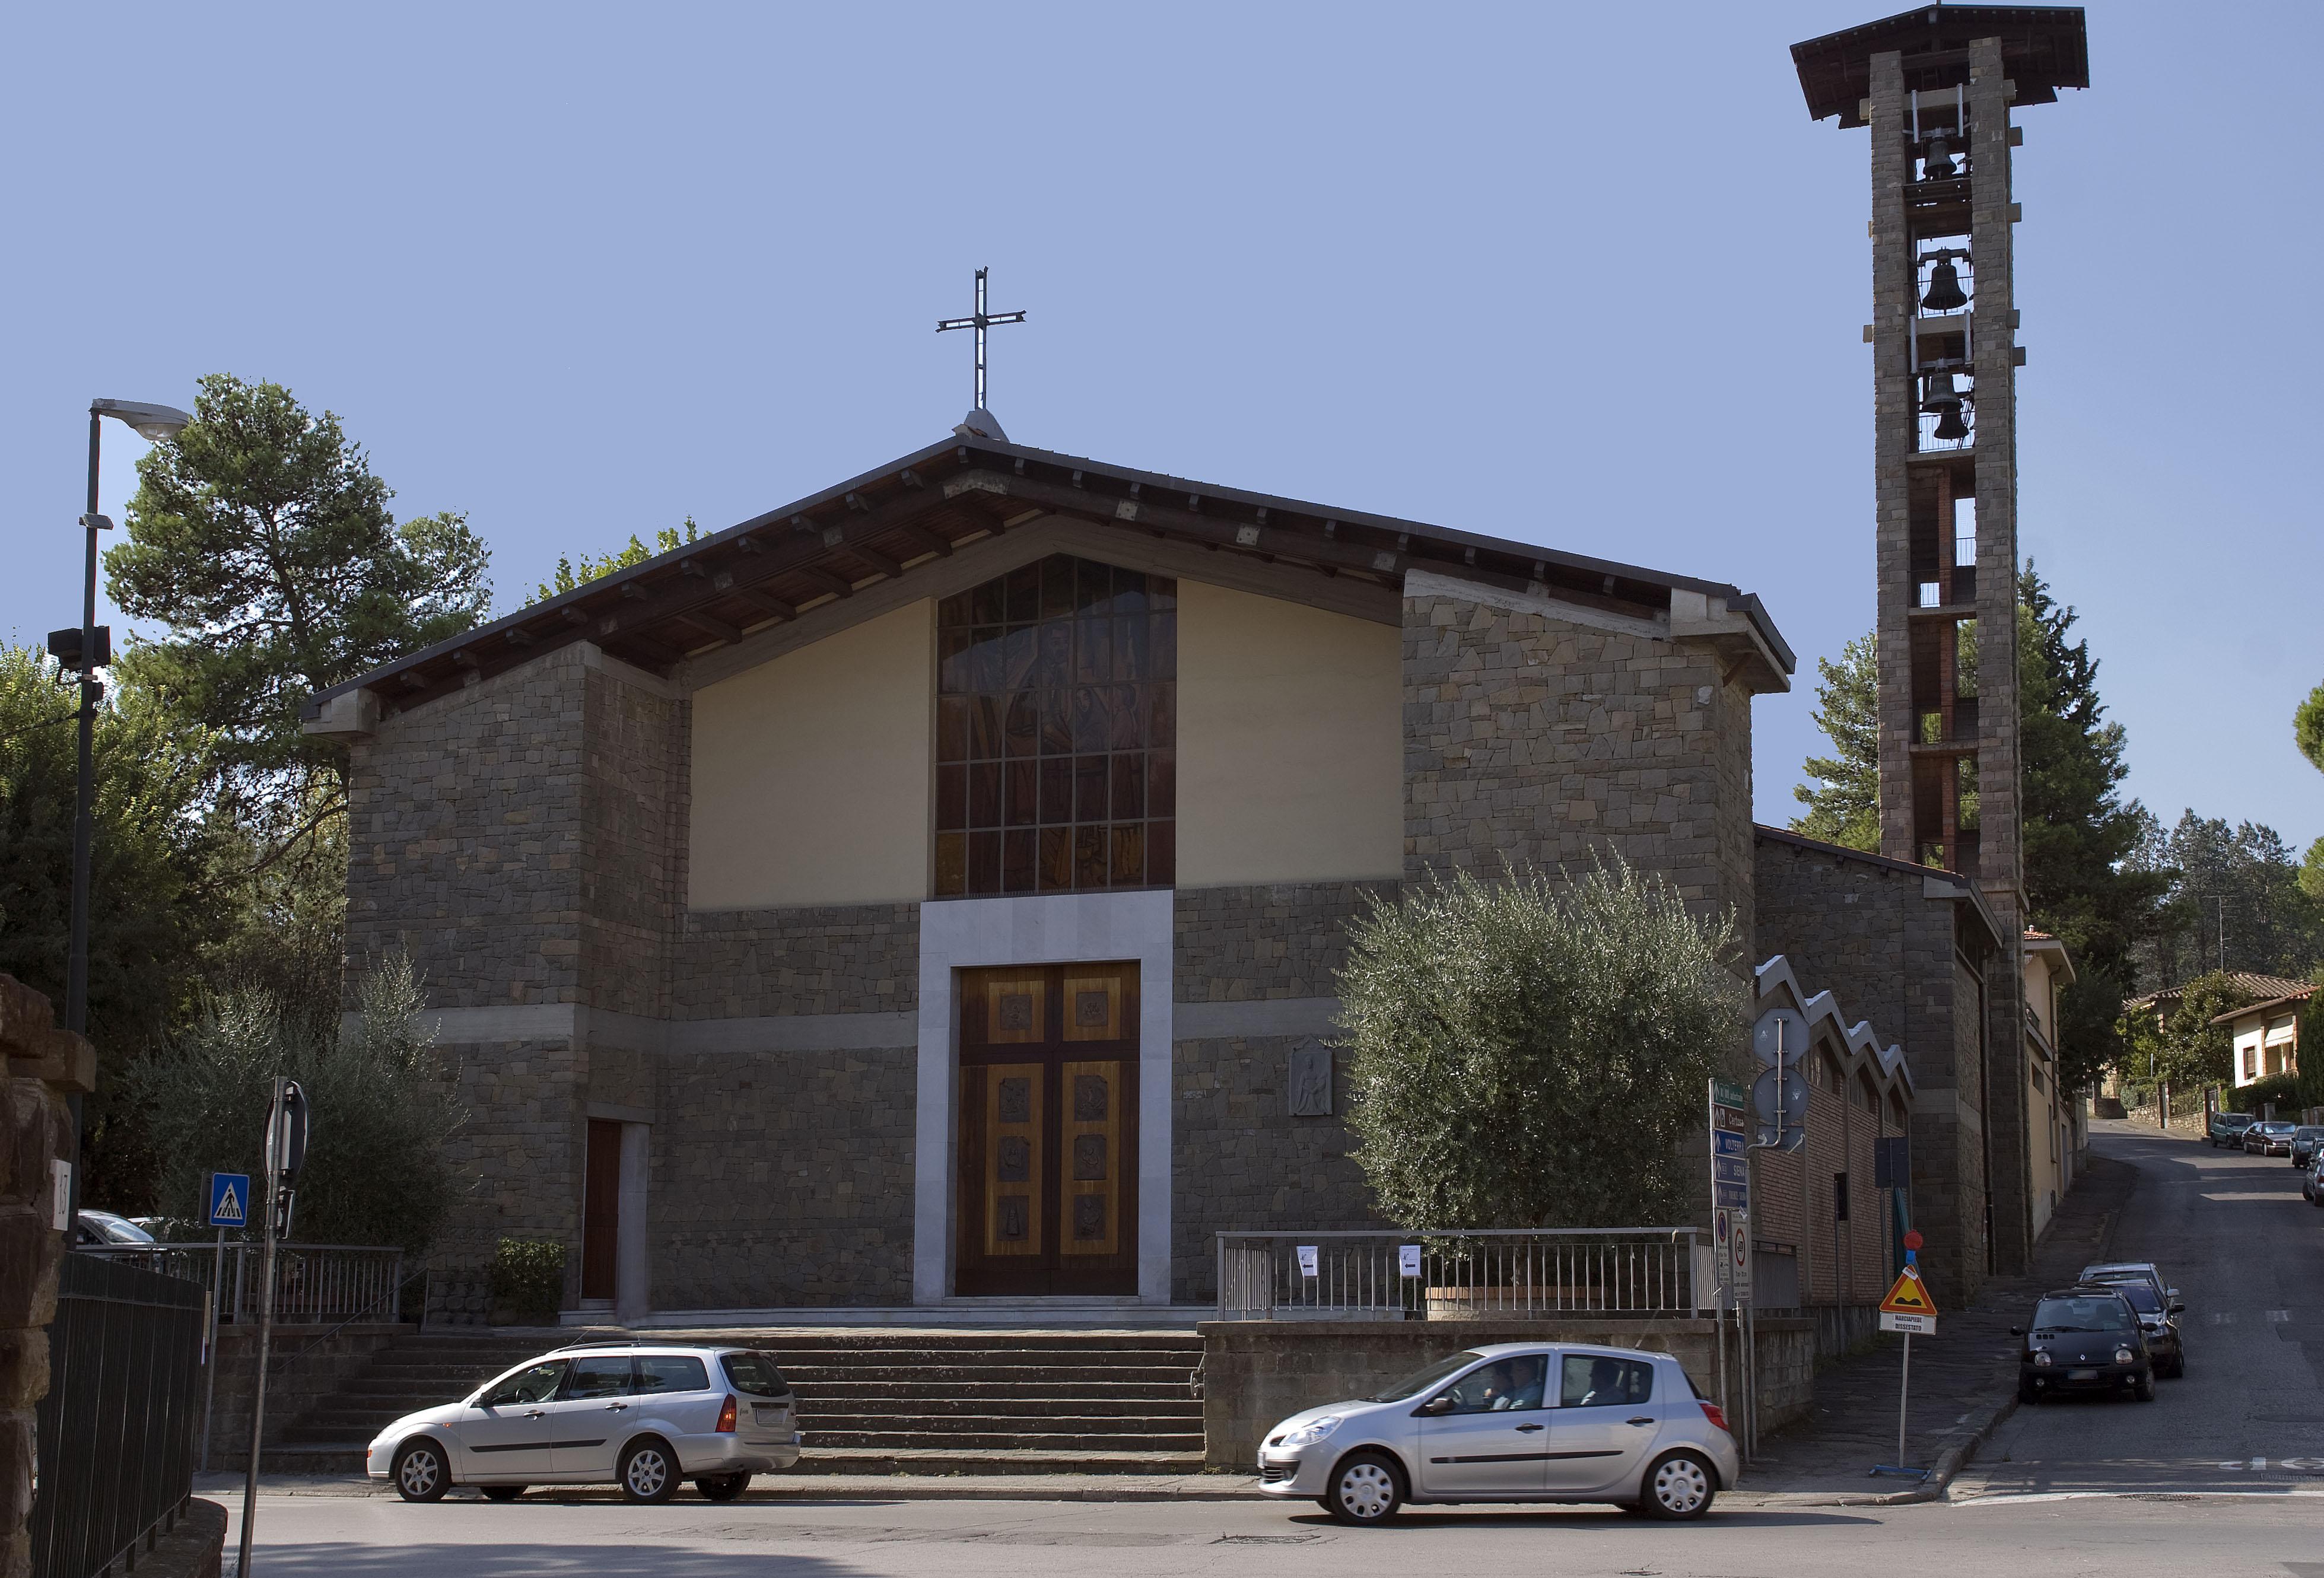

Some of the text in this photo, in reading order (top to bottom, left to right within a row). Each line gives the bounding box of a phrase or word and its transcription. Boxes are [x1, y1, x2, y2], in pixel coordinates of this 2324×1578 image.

[1728, 1113, 1744, 1127] Certosa
[1725, 1138, 1744, 1153] VOLTERRA
[1733, 1165, 1746, 1177] SIENA
[58, 1173, 68, 1214] 13
[1894, 1315, 1922, 1323] MARCIAPIEDE
[1895, 1323, 1922, 1331] DISSESTATO
